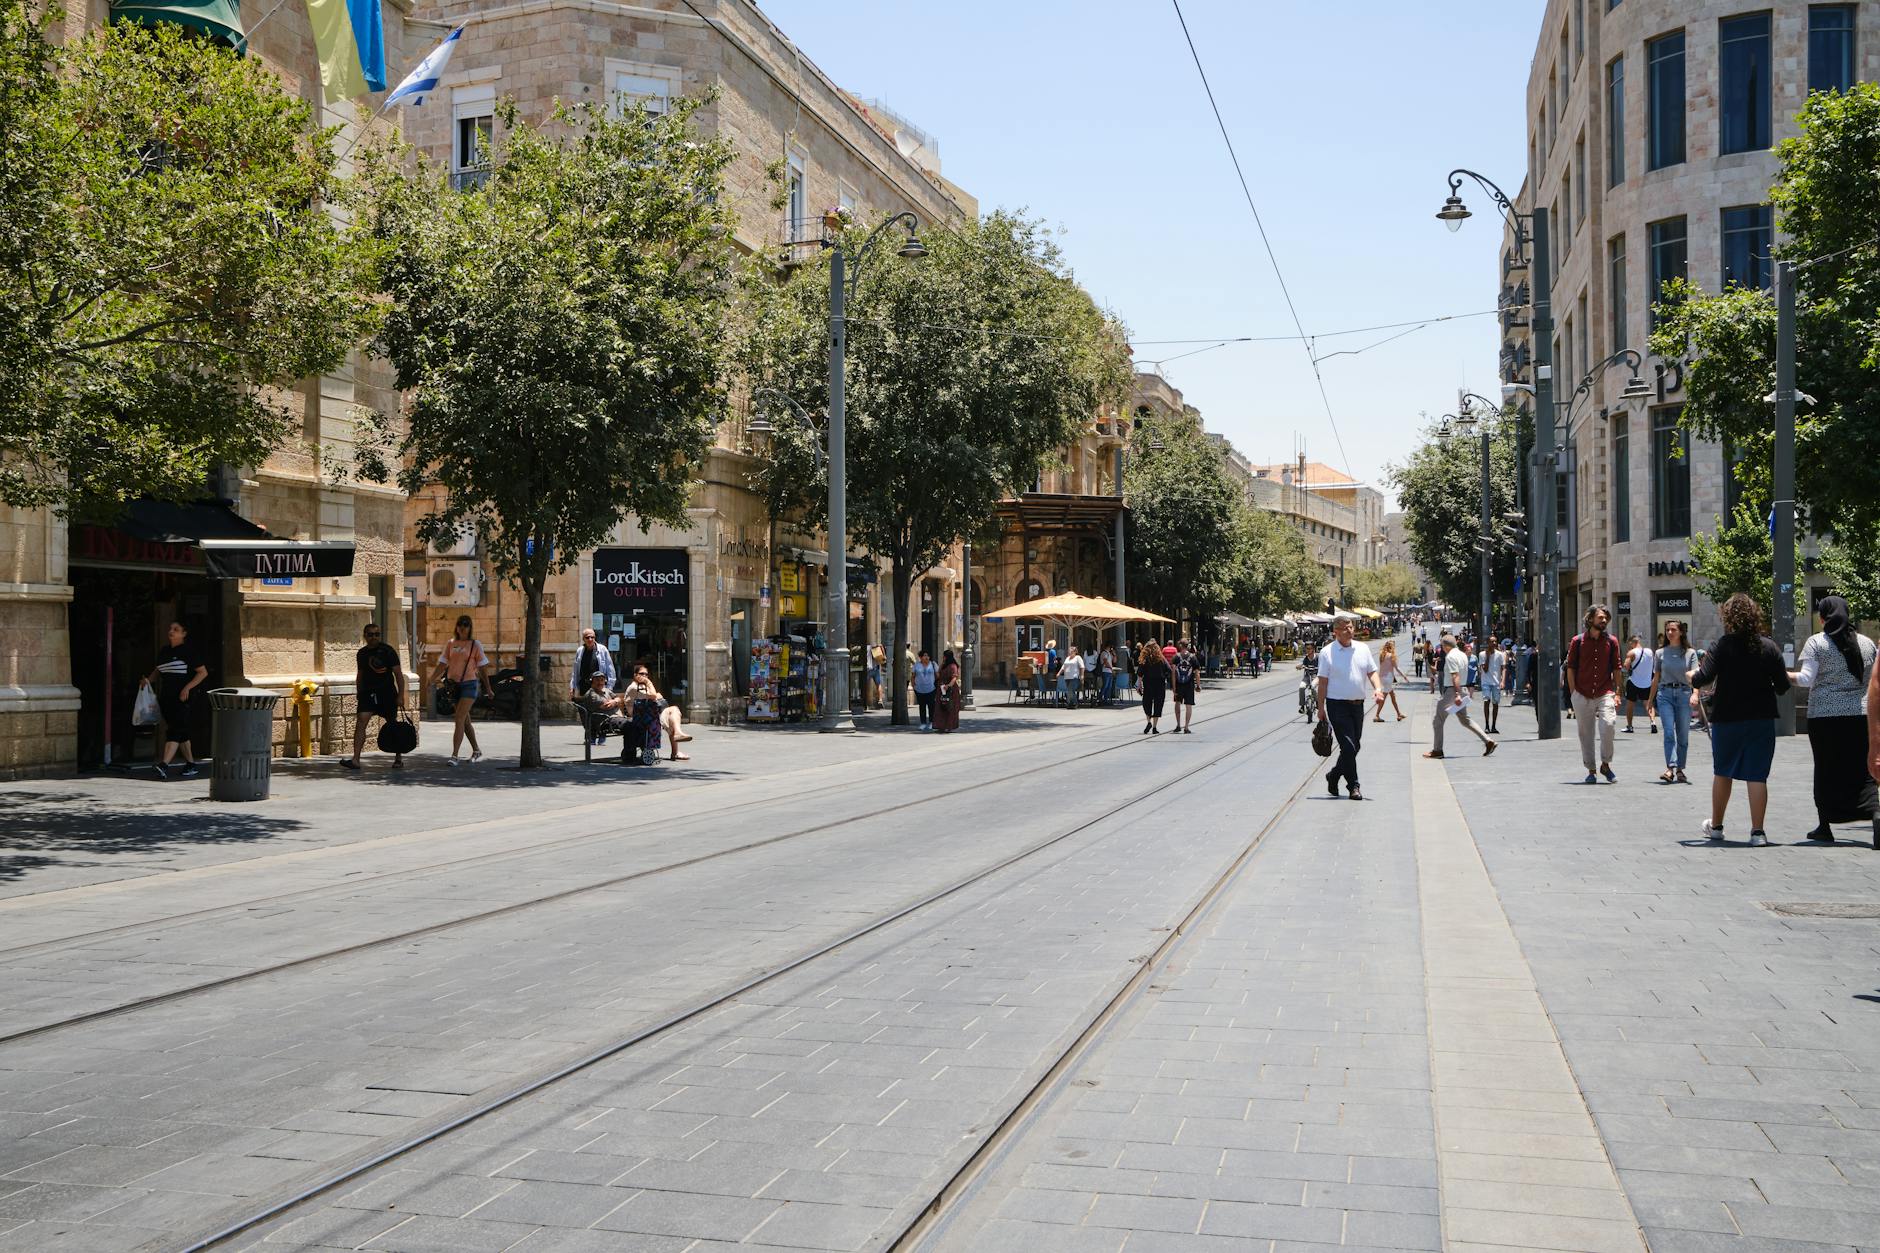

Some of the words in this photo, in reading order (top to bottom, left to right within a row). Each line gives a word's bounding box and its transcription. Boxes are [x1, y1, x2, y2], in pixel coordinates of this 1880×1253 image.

[255, 553, 316, 574] INTIMA
[614, 587, 666, 597] OUTLET
[1658, 599, 1689, 608] MASHBIR
